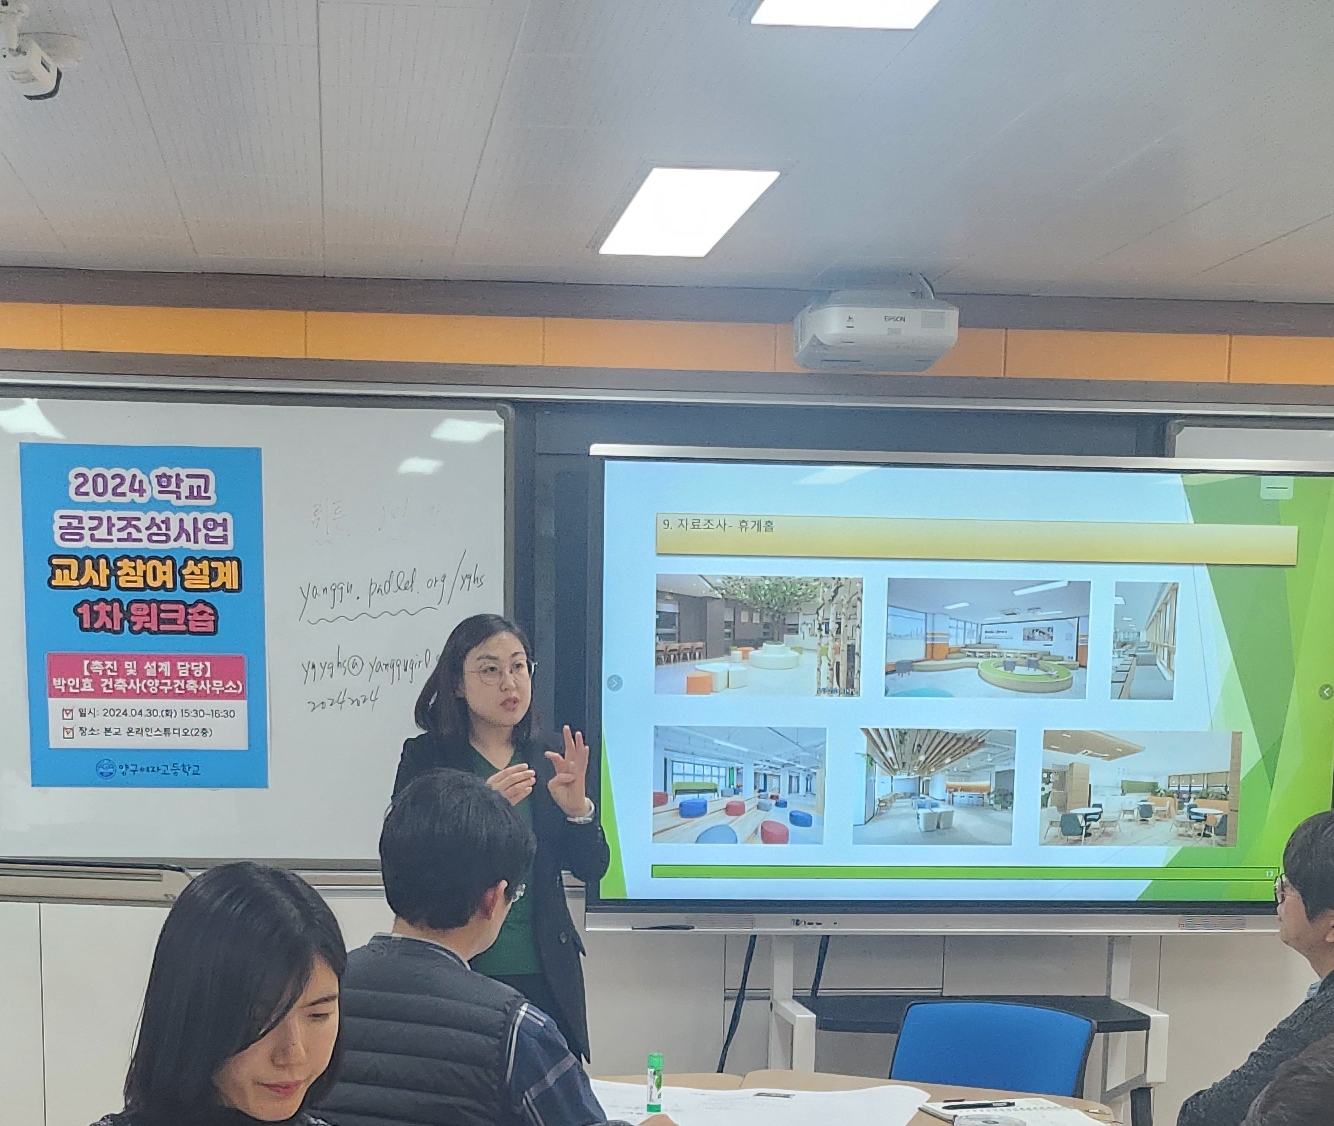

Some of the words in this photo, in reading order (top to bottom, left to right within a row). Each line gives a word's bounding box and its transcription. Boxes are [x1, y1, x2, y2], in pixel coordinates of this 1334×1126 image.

[73, 472, 147, 498] 2024
[154, 472, 212, 501] 학교
[58, 514, 229, 545] 공간조성사업
[662, 518, 673, 530] 9.
[50, 557, 110, 588] 교사
[116, 558, 174, 589] 참여
[182, 559, 239, 590] 설계
[77, 601, 123, 631] 1차
[130, 602, 216, 633] 워크숍
[124, 660, 137, 676] 및
[143, 660, 171, 677] 설계
[52, 677, 95, 693] 박인효
[100, 678, 243, 695] 건축사(양구건축사무소)
[78, 707, 99, 718] 일시:
[78, 726, 100, 737] 장소:
[103, 727, 122, 737] 본교
[118, 762, 201, 777] 양구여자고등학교
